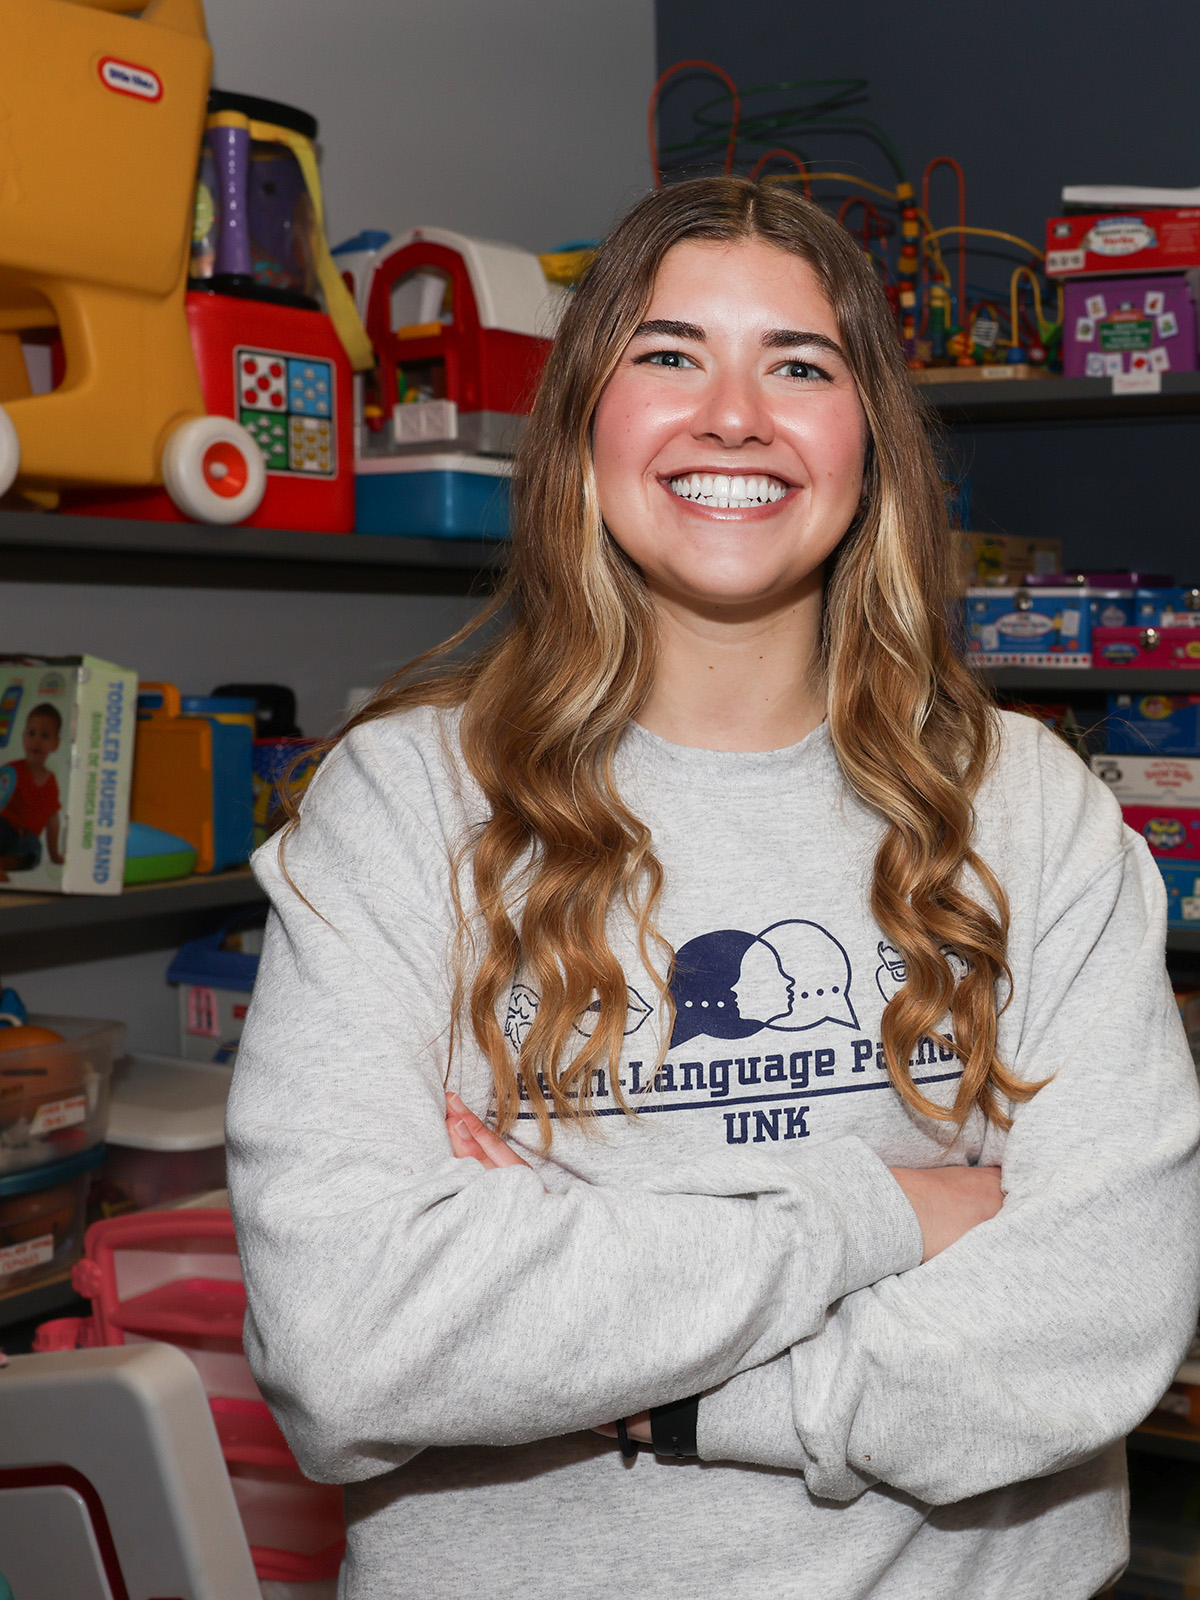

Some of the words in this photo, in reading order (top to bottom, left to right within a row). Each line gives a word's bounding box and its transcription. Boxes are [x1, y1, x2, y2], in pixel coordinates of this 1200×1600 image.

[103, 680, 124, 764] TODDLER
[97, 768, 118, 829] MUSIC
[92, 834, 113, 886] BAND
[723, 1106, 811, 1145] UNK
